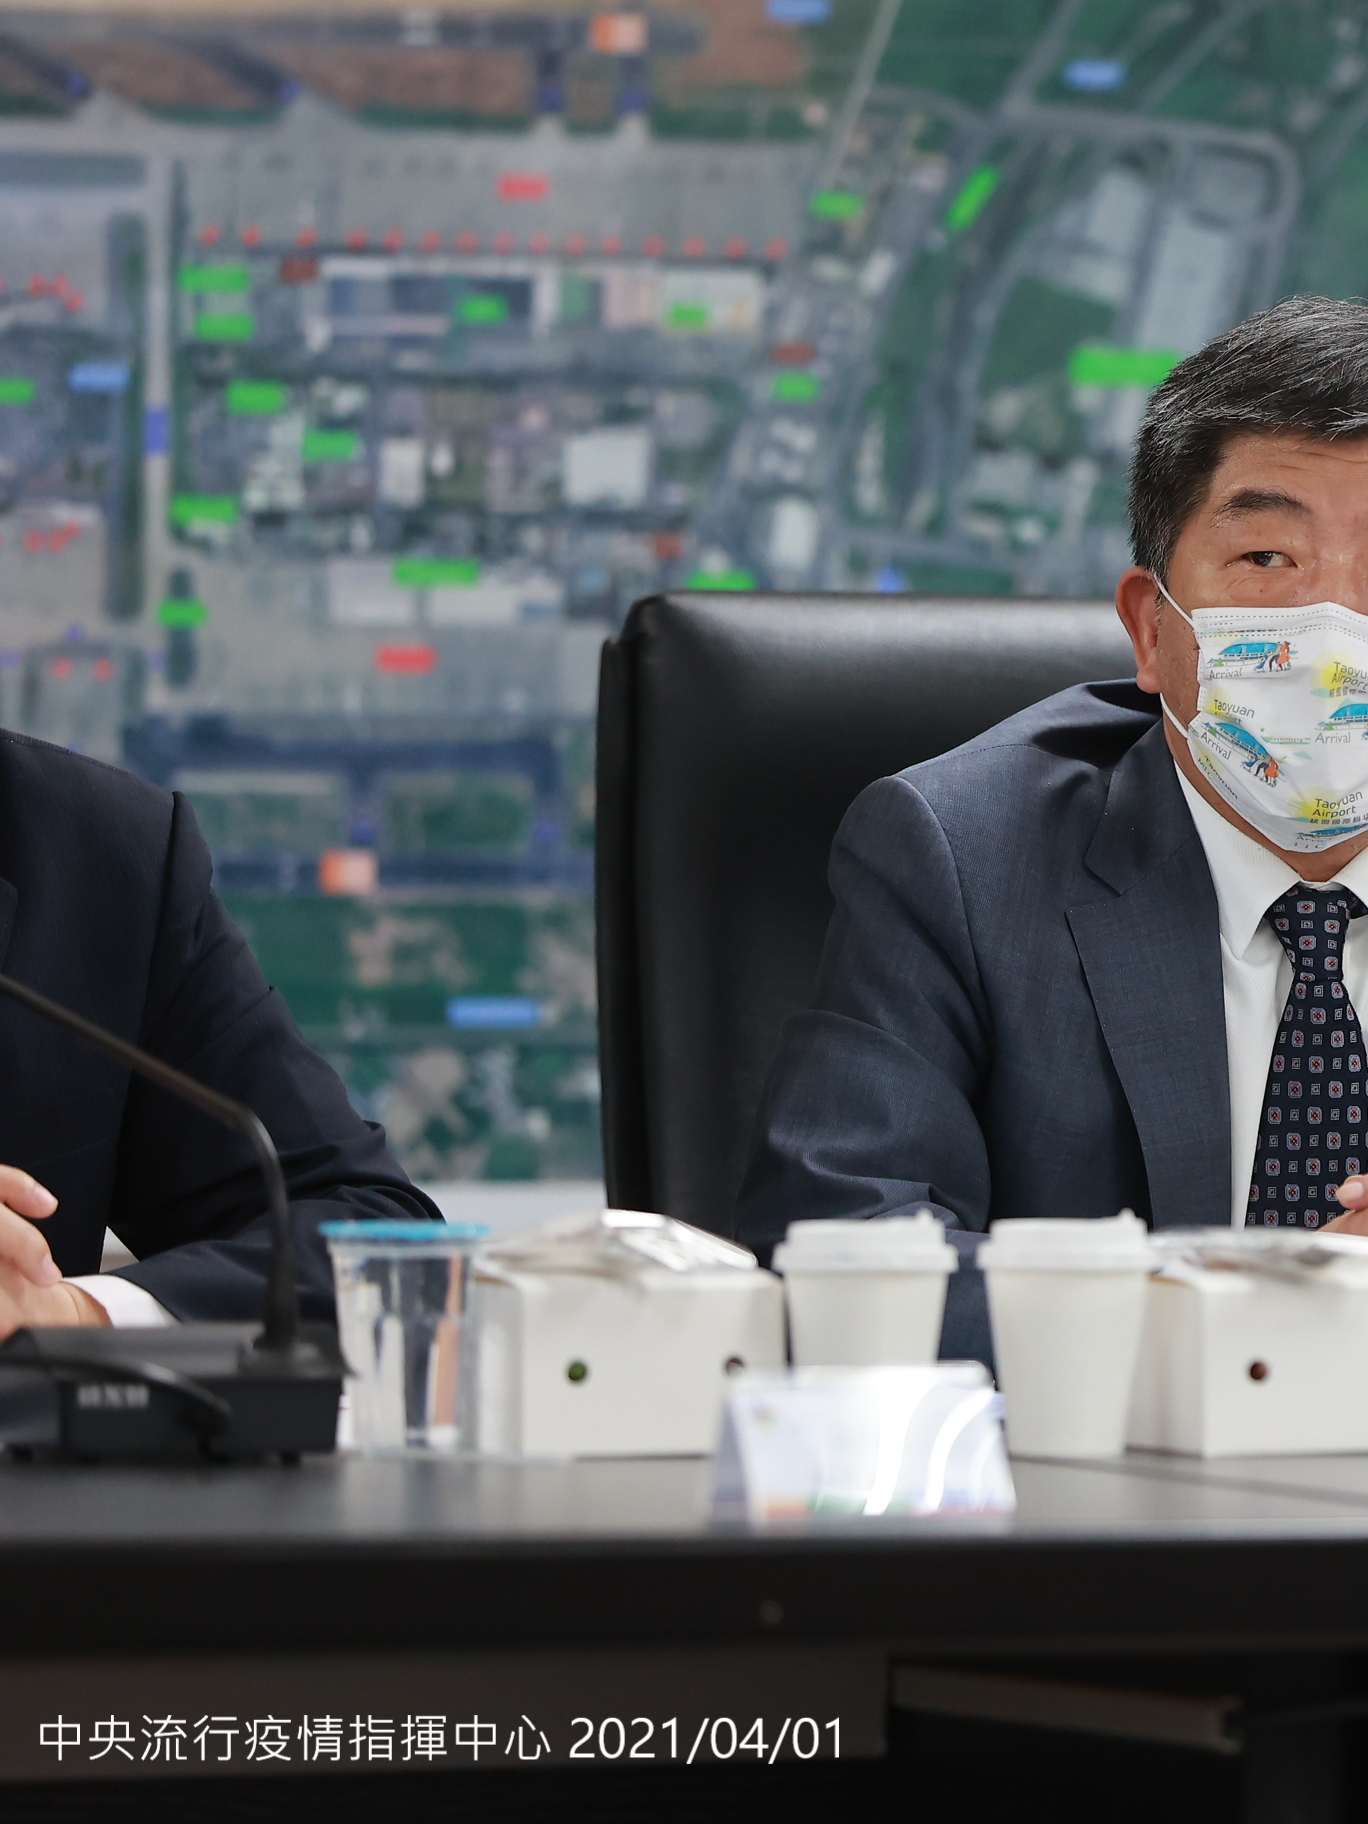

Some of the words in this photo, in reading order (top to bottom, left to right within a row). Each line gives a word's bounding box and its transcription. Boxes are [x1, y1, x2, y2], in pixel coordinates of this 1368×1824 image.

[1209, 667, 1243, 680] Arrival
[1331, 673, 1368, 691] Airport
[1213, 699, 1255, 718] Taoyuan
[1200, 732, 1232, 761] Arrival
[1315, 731, 1351, 744] Arrival
[1315, 791, 1363, 810] Taoyuan
[1312, 805, 1357, 819] Airport
